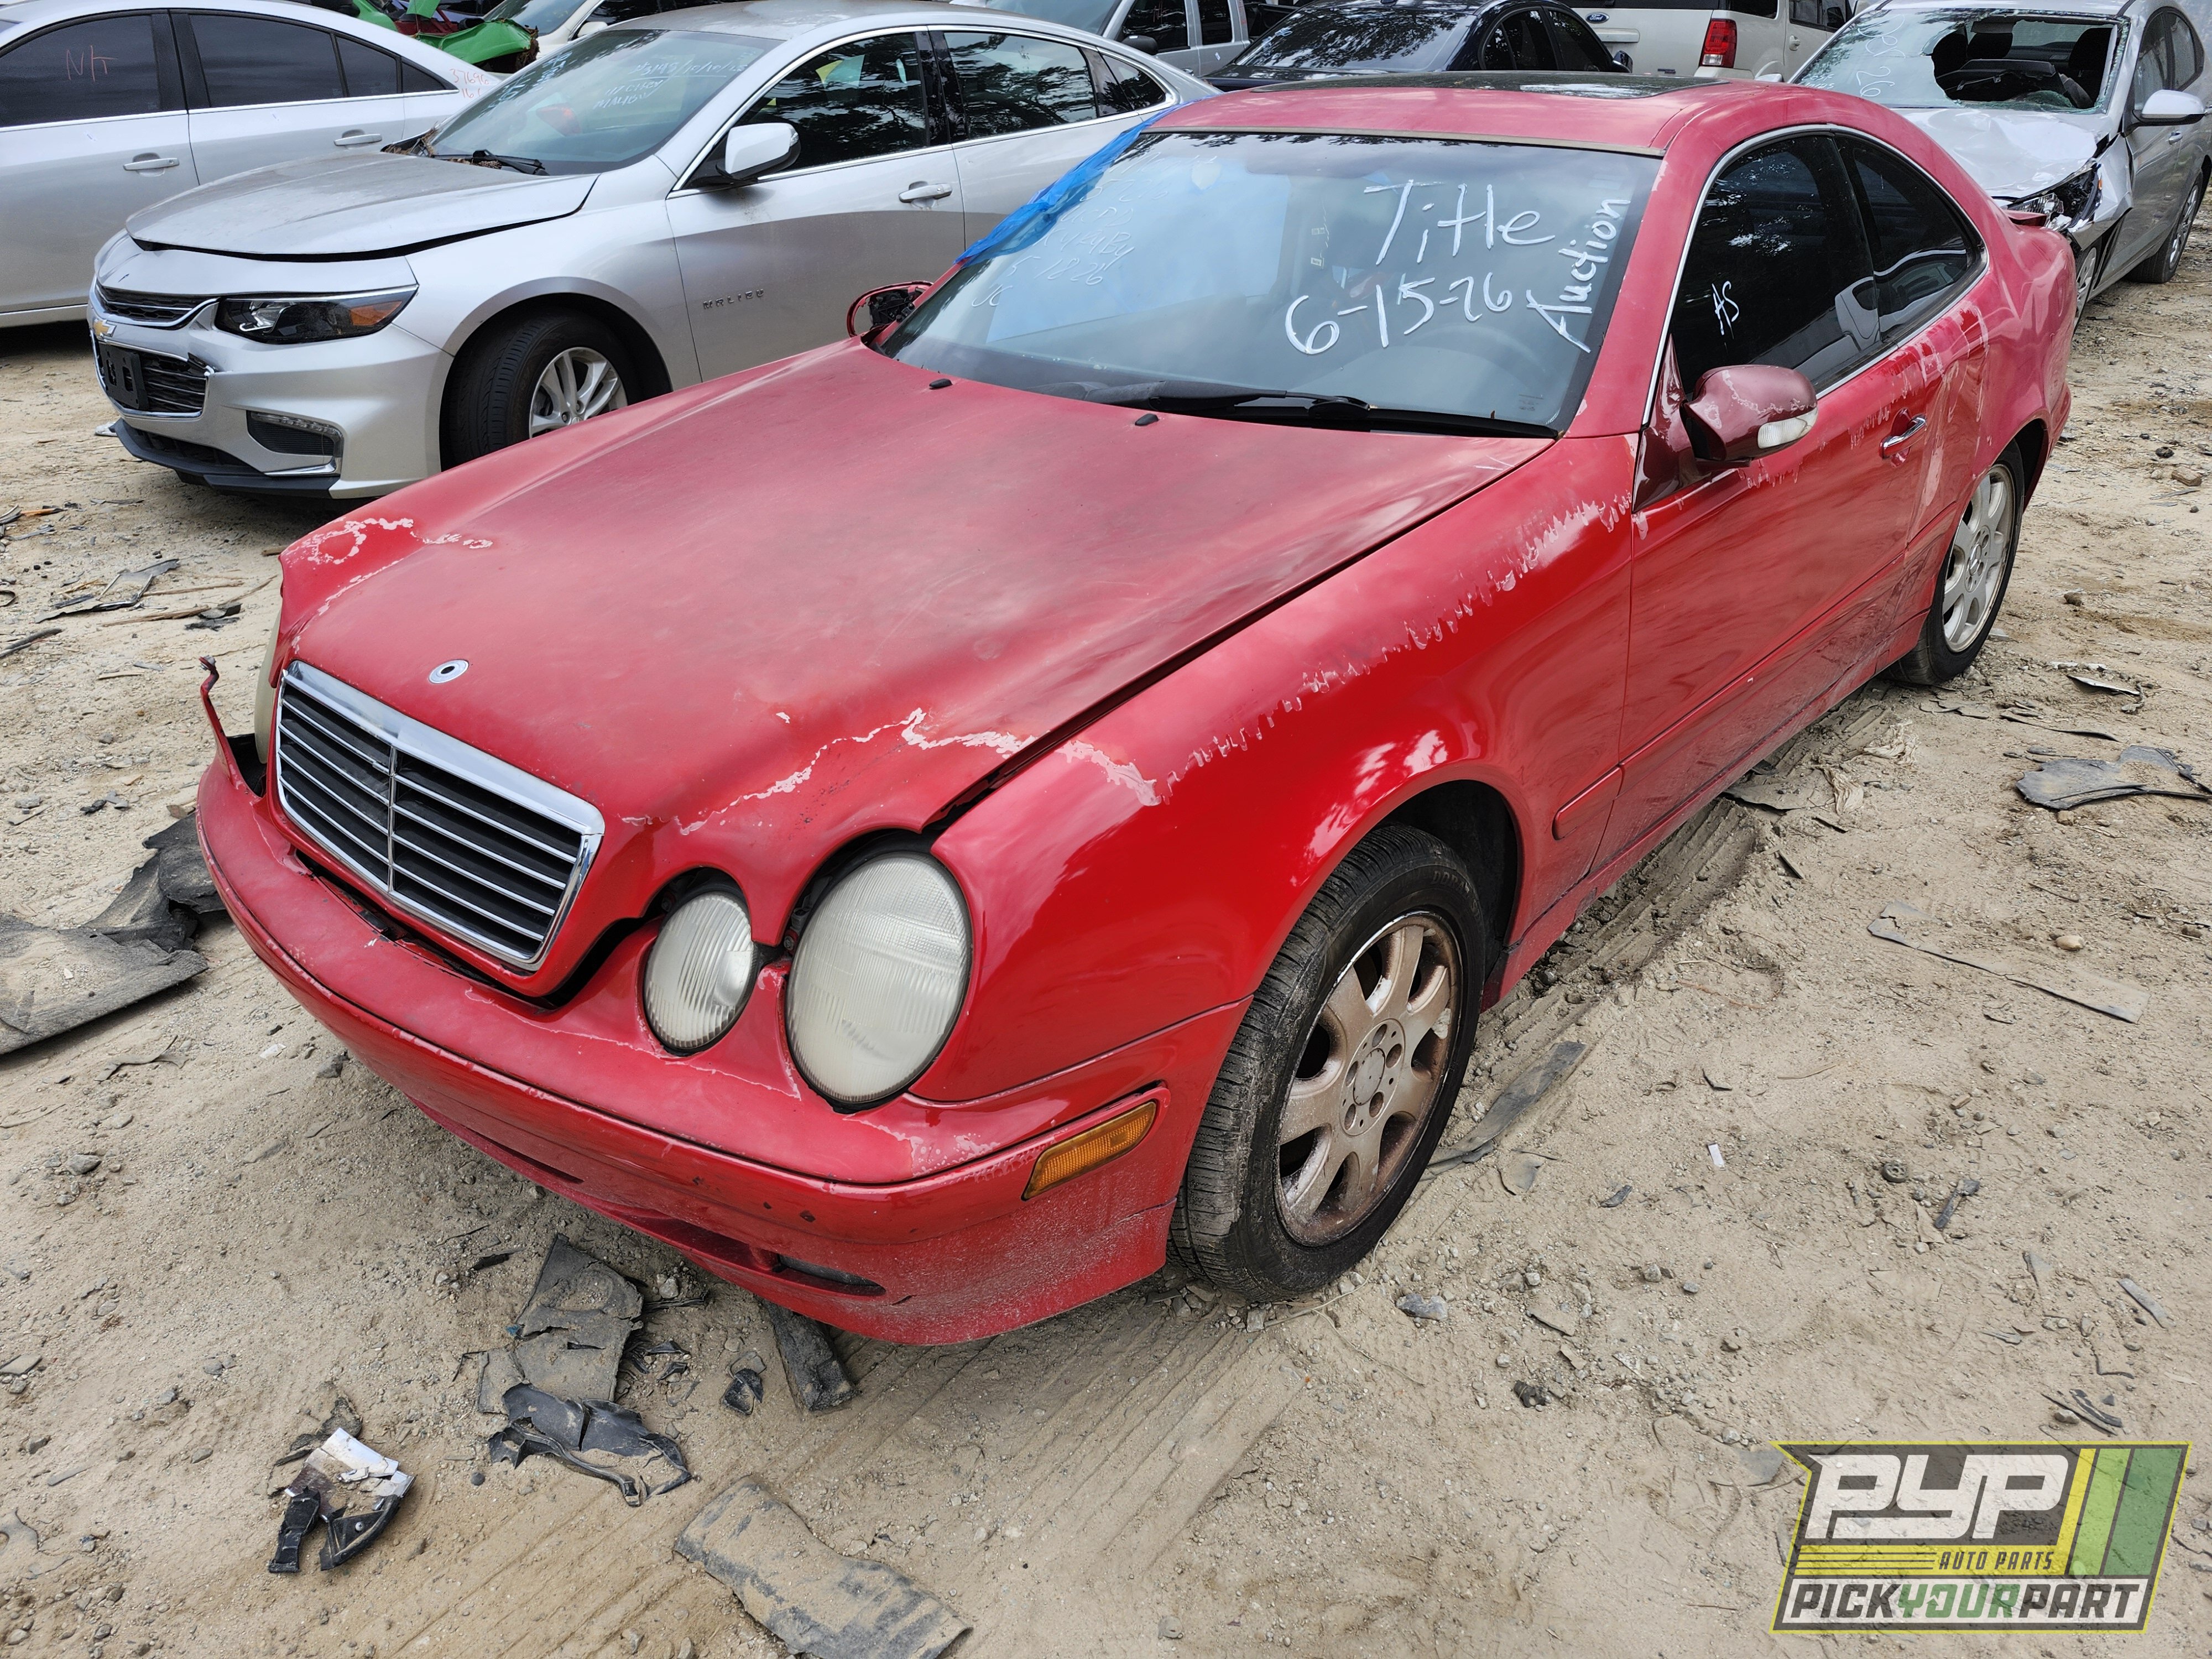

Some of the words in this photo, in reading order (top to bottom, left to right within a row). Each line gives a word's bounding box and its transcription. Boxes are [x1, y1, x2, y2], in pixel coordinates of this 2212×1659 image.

[1364, 179, 1556, 265] Title
[702, 288, 764, 310] MALIBU
[1526, 199, 1631, 353] Auction
